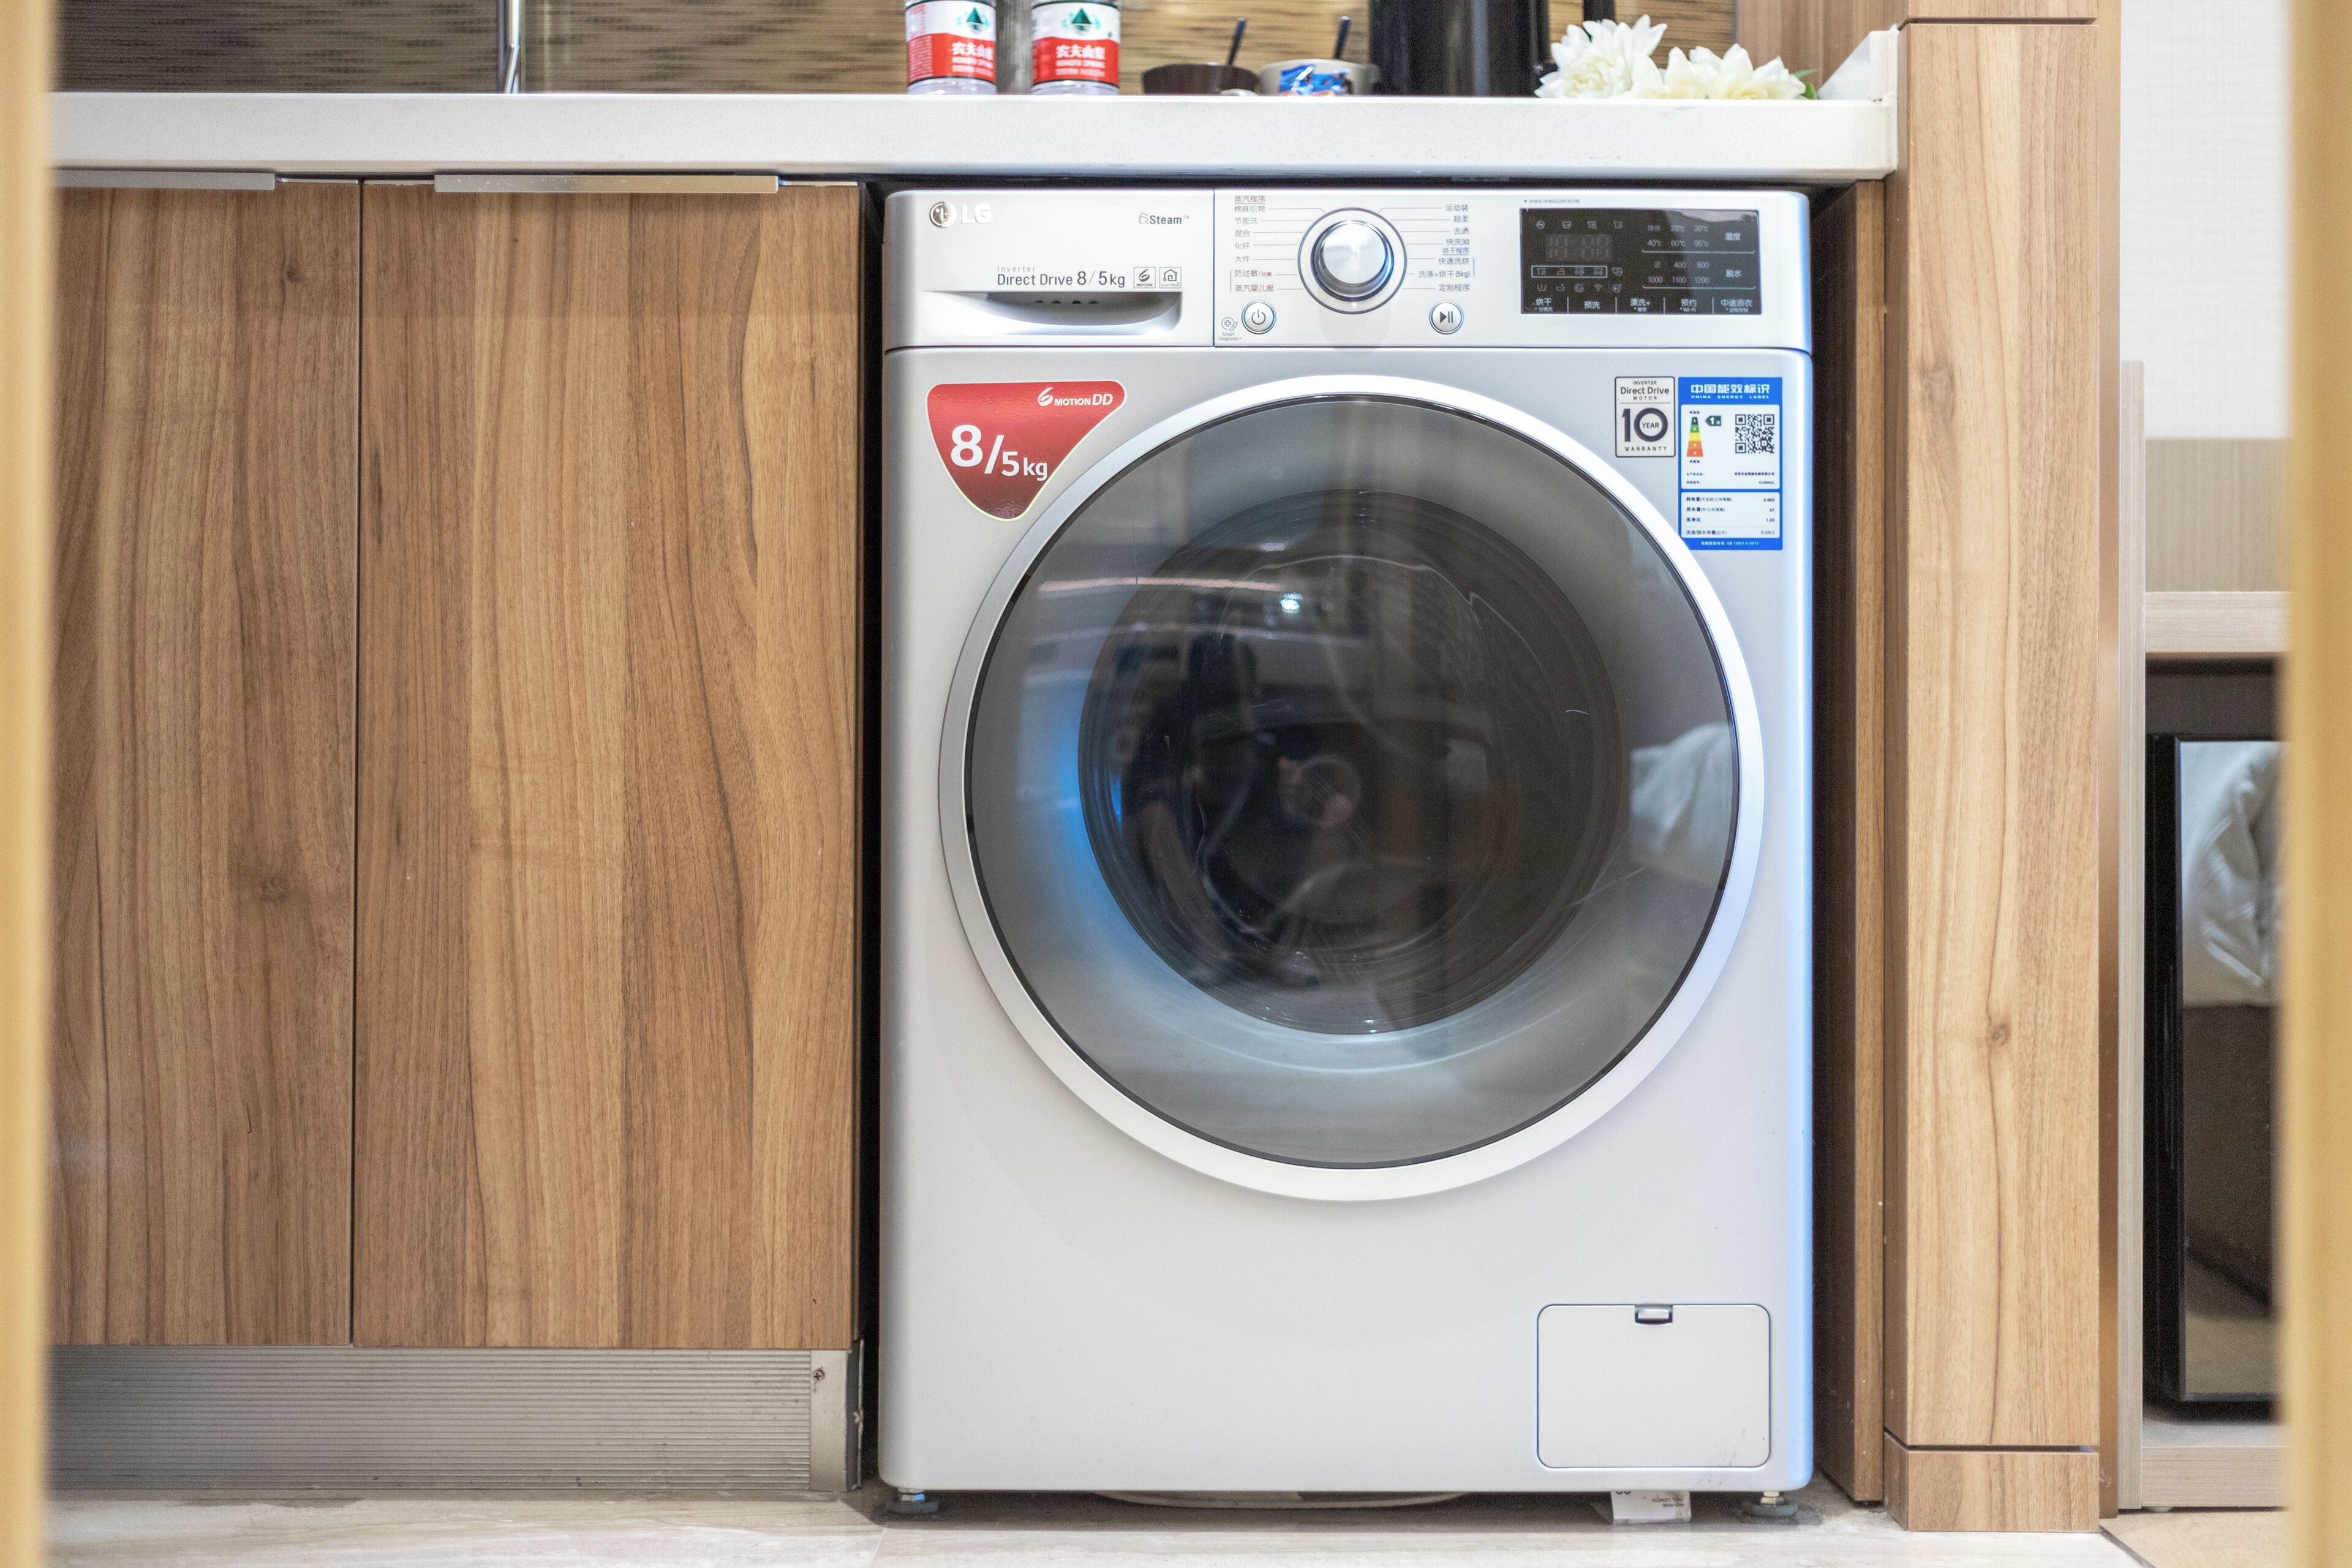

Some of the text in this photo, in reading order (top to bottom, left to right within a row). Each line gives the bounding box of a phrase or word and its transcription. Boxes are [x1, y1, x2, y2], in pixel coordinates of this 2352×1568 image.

[961, 203, 992, 225] LG
[997, 273, 1036, 285] Direct
[1040, 273, 1073, 285] Drive
[1691, 383, 1770, 394] 中国能效标识
[1621, 407, 1668, 443] 10
